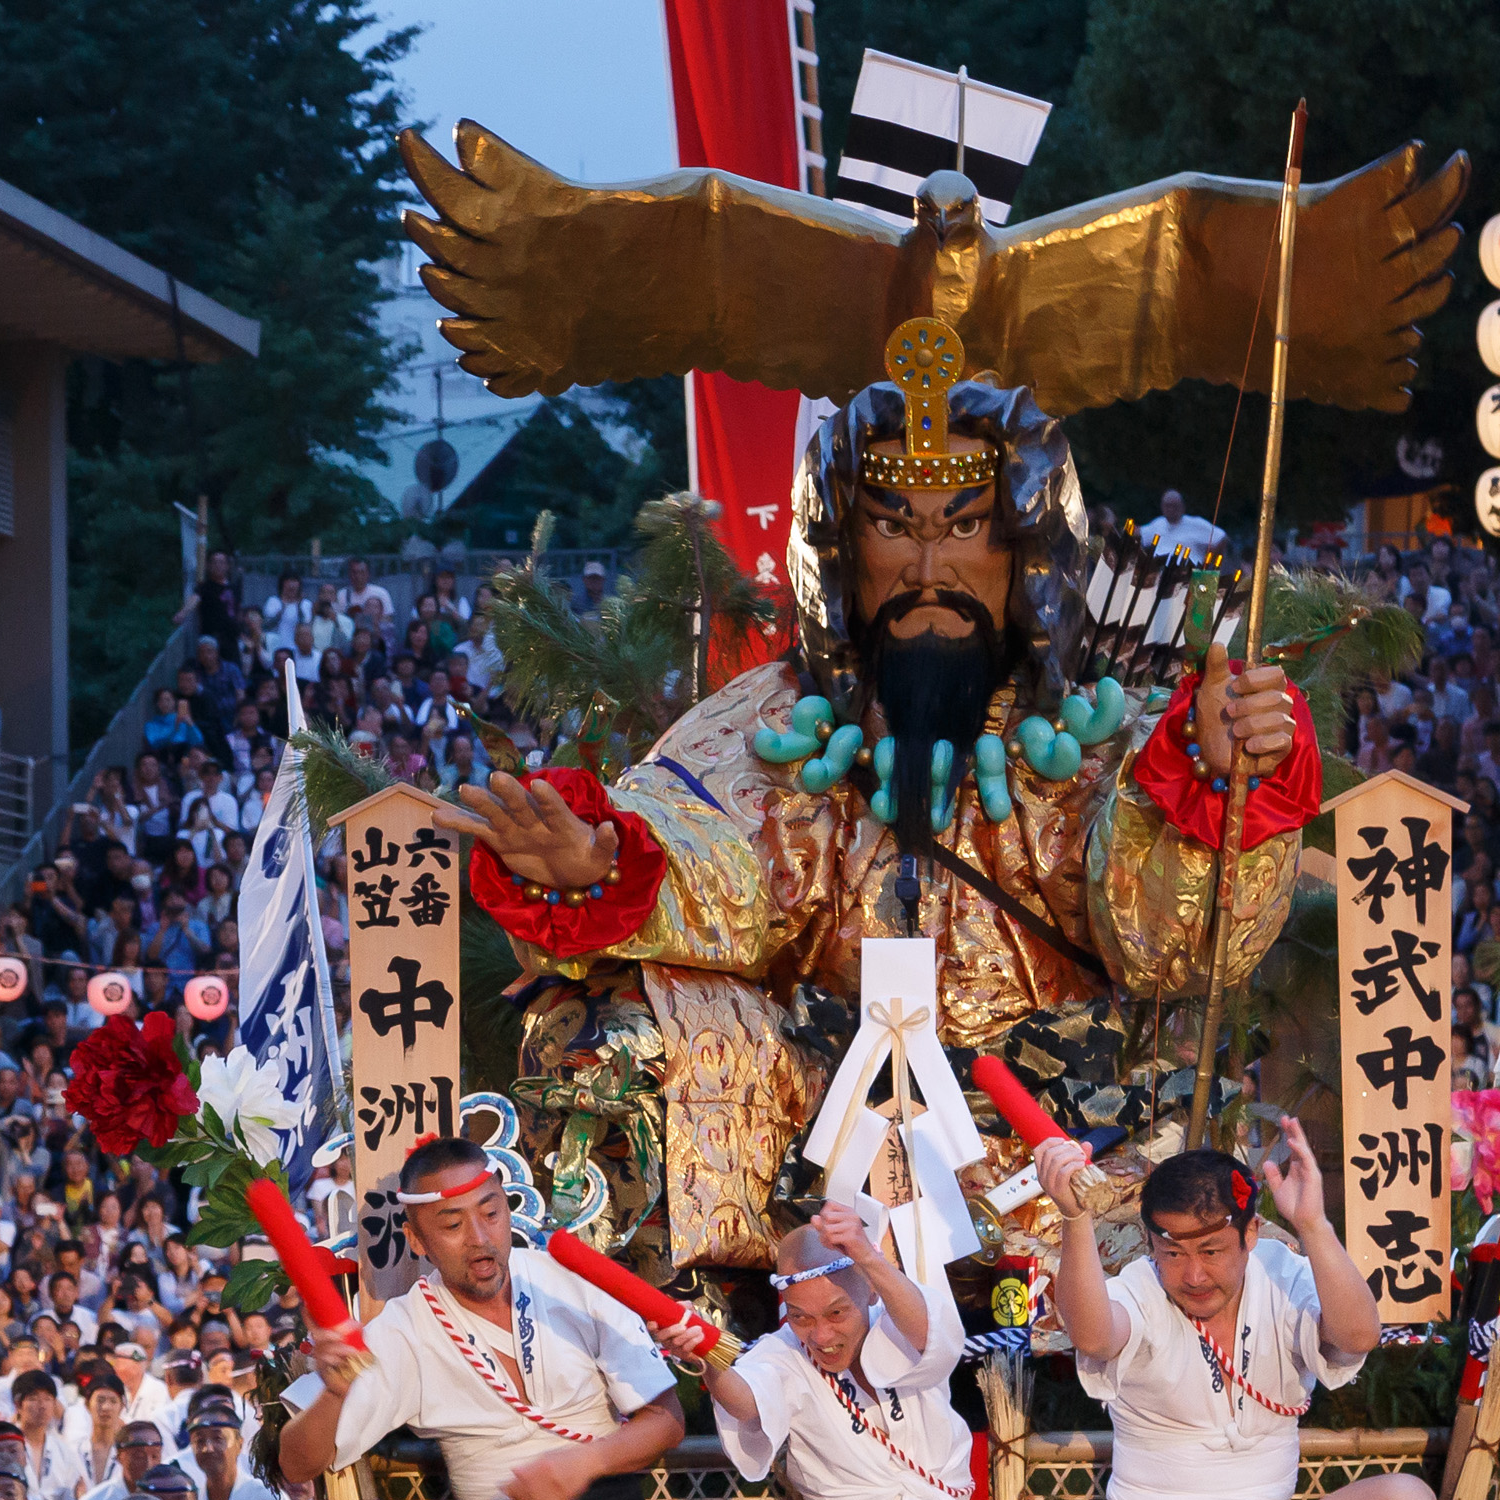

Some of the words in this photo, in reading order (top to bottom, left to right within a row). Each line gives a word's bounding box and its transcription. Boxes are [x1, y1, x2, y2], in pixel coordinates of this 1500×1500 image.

[352, 827, 400, 929] 山笠
[399, 827, 452, 928] 六番
[1346, 816, 1450, 1304] 神武中洲志
